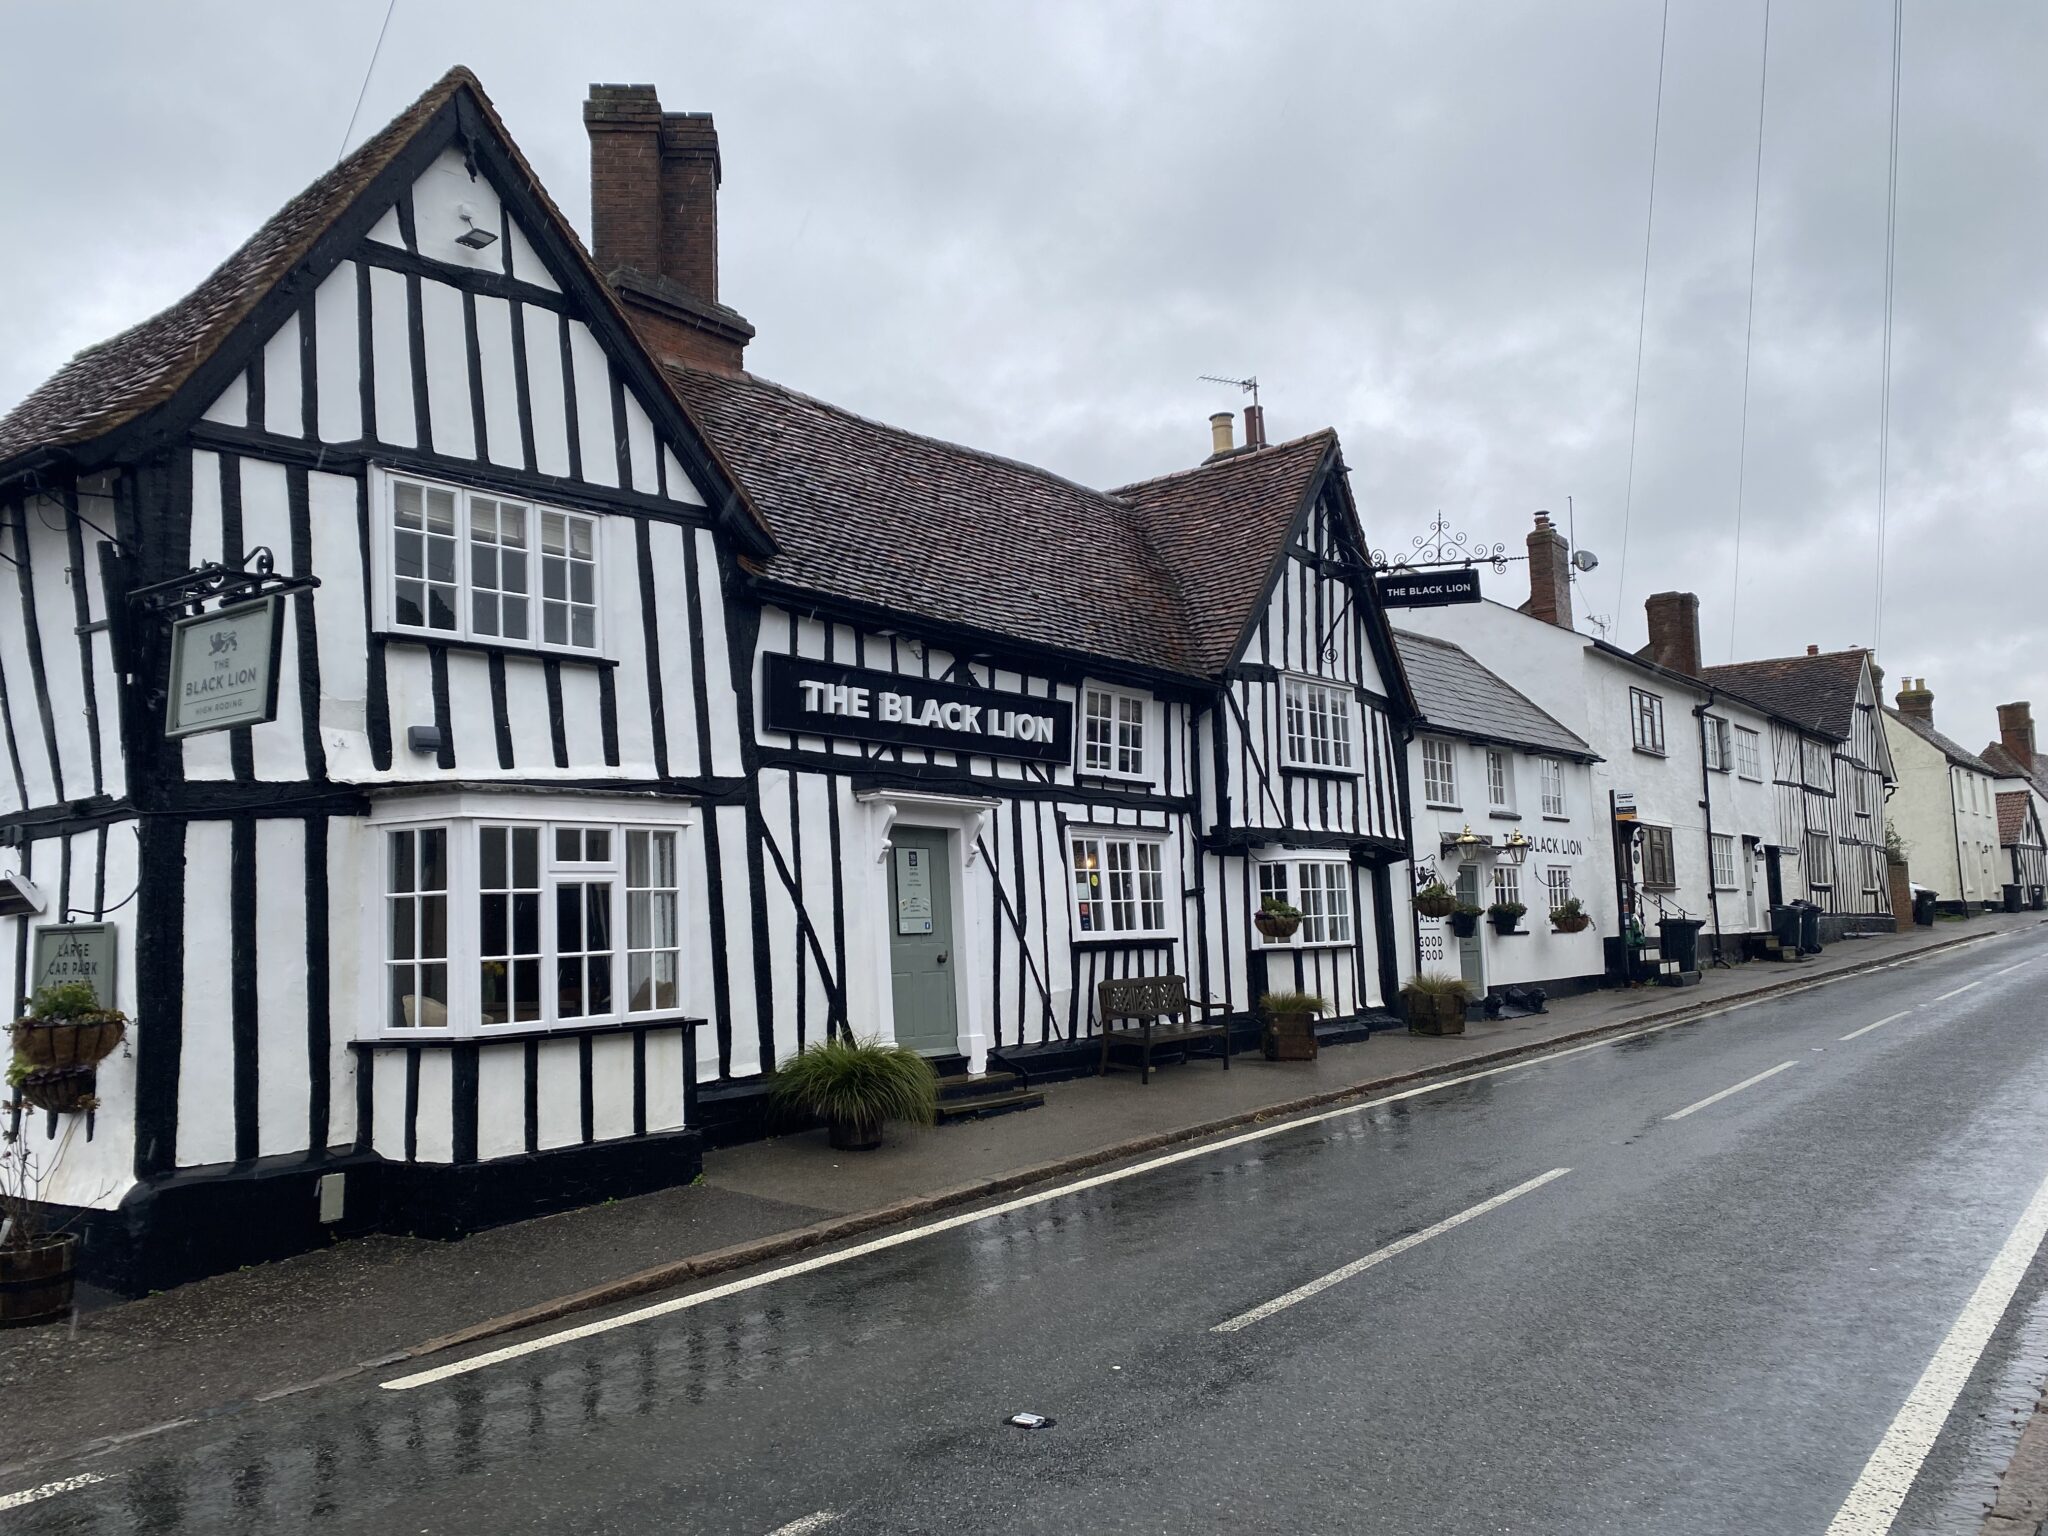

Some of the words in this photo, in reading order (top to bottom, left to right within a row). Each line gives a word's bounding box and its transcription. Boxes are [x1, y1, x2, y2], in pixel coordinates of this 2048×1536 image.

[1386, 587, 1406, 597] THE
[1409, 585, 1443, 595] BLACK
[1446, 583, 1471, 593] LION
[213, 658, 230, 670] THE
[185, 674, 224, 697] BLACK
[228, 667, 257, 687] LION
[214, 698, 243, 712] RODING
[799, 679, 870, 719] THE
[878, 691, 982, 734] BLACK
[987, 708, 1054, 744] LION
[1527, 835, 1560, 854] BLACK
[1561, 838, 1583, 856] LION
[1419, 936, 1443, 947] GOOD
[58, 943, 90, 957] LARGE
[1420, 949, 1444, 961] FOOD
[48, 961, 68, 975] CAR
[72, 961, 98, 975] PARK
